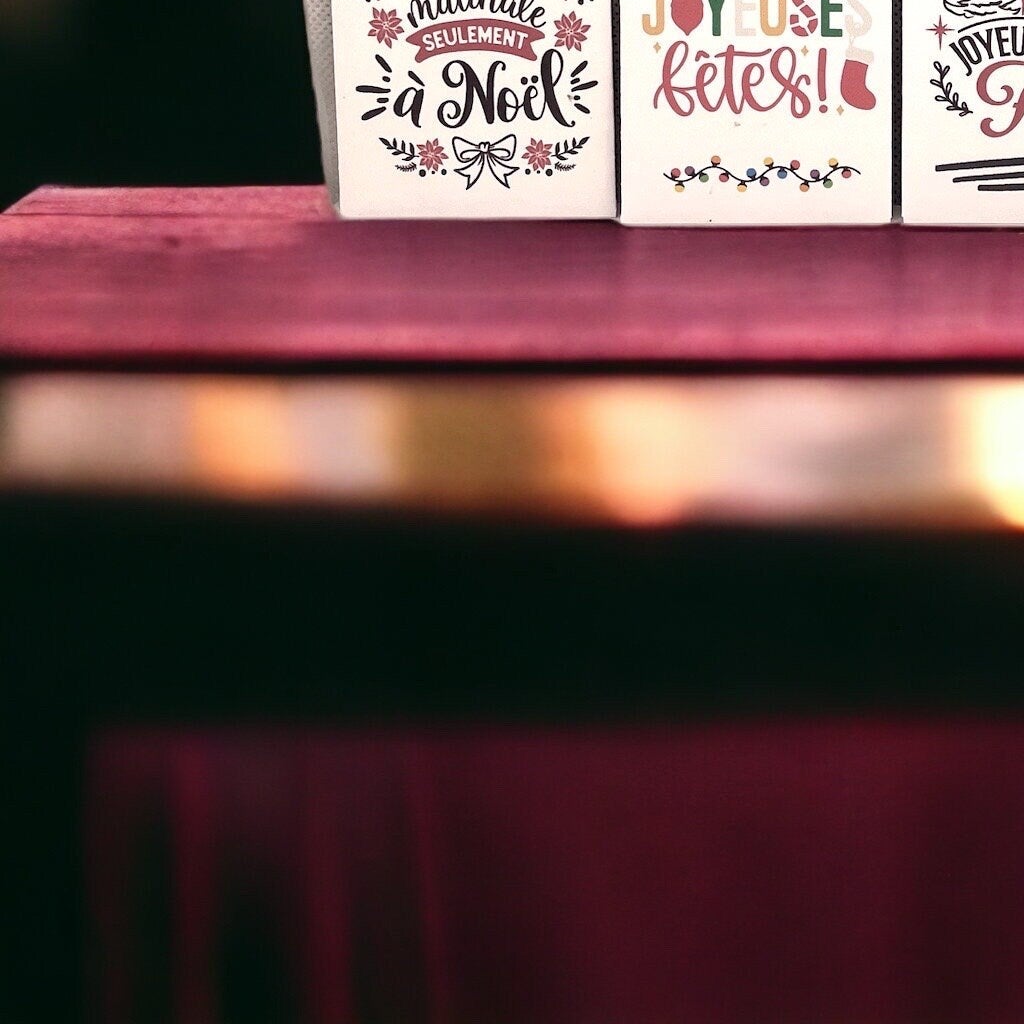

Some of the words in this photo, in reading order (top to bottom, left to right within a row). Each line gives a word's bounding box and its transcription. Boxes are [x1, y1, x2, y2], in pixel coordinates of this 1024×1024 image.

[421, 24, 529, 52] SEULEMENT
[393, 70, 426, 129] à
[437, 48, 576, 129] Noël
[653, 40, 829, 119] fêtes!
